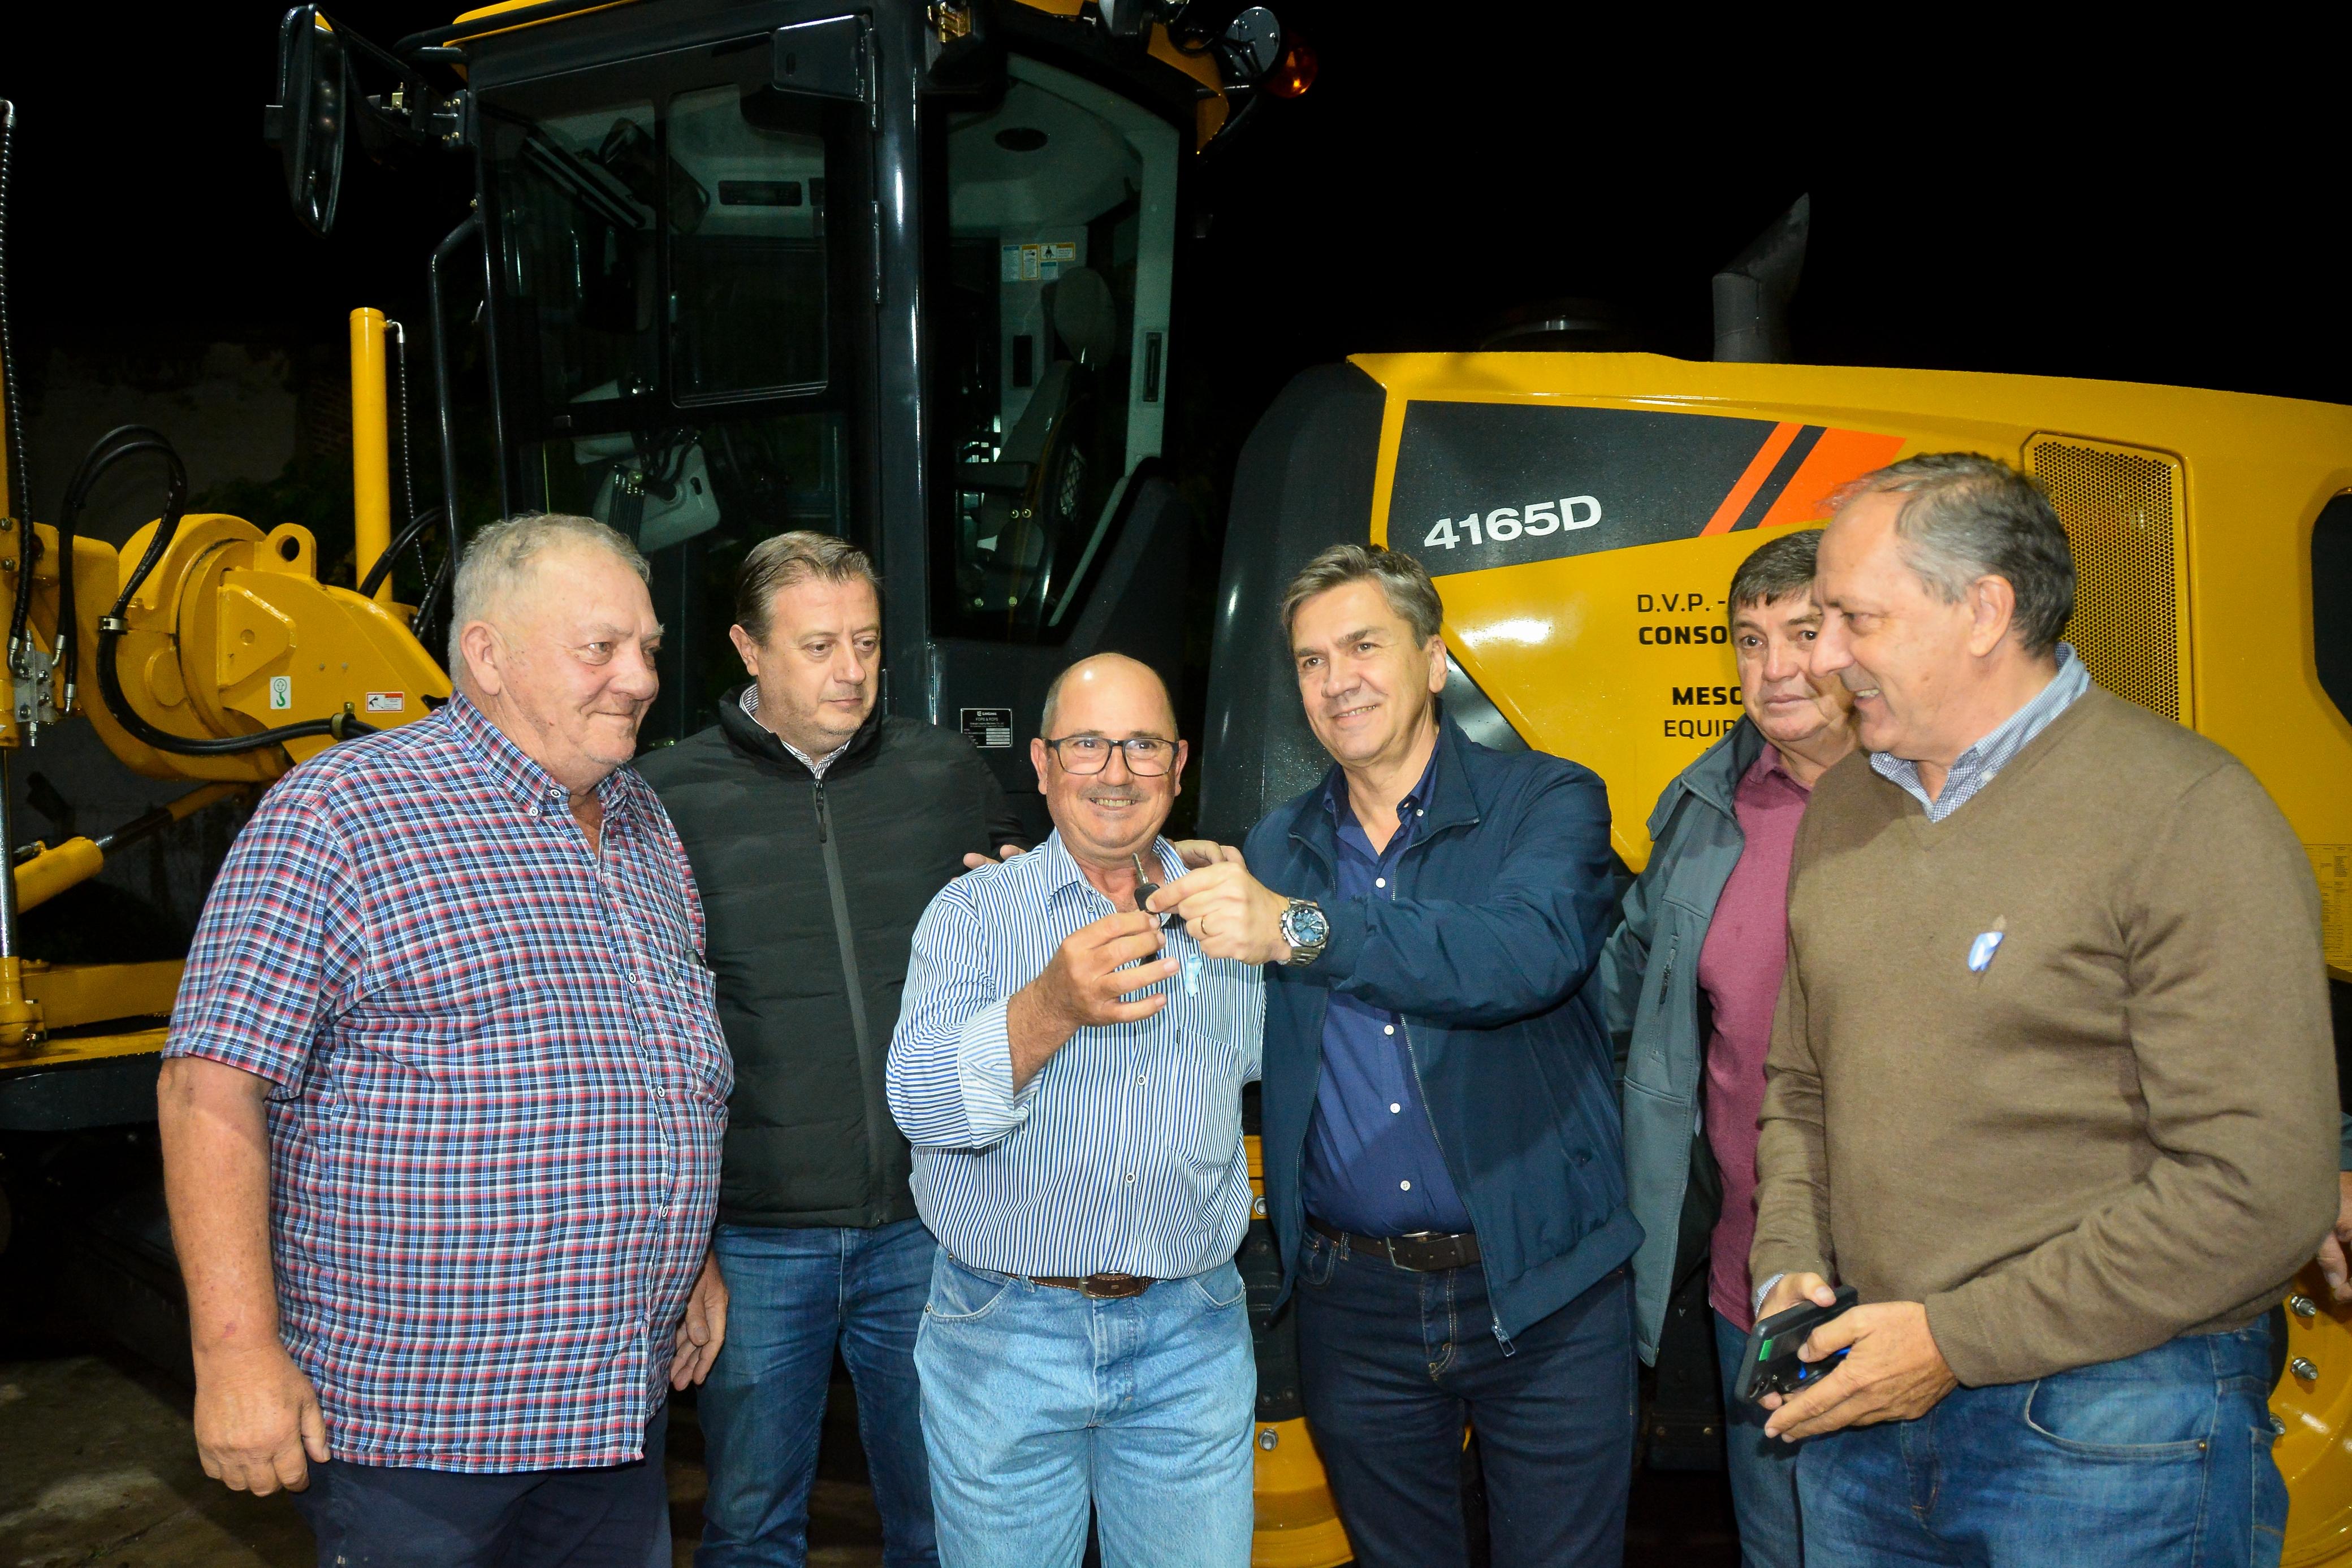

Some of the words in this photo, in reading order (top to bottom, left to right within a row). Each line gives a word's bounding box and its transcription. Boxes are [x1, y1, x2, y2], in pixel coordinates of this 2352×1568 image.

[1424, 495, 1602, 549] 4165D
[1637, 593, 1710, 612] D.V.P.
[1640, 626, 1727, 644] CONSO
